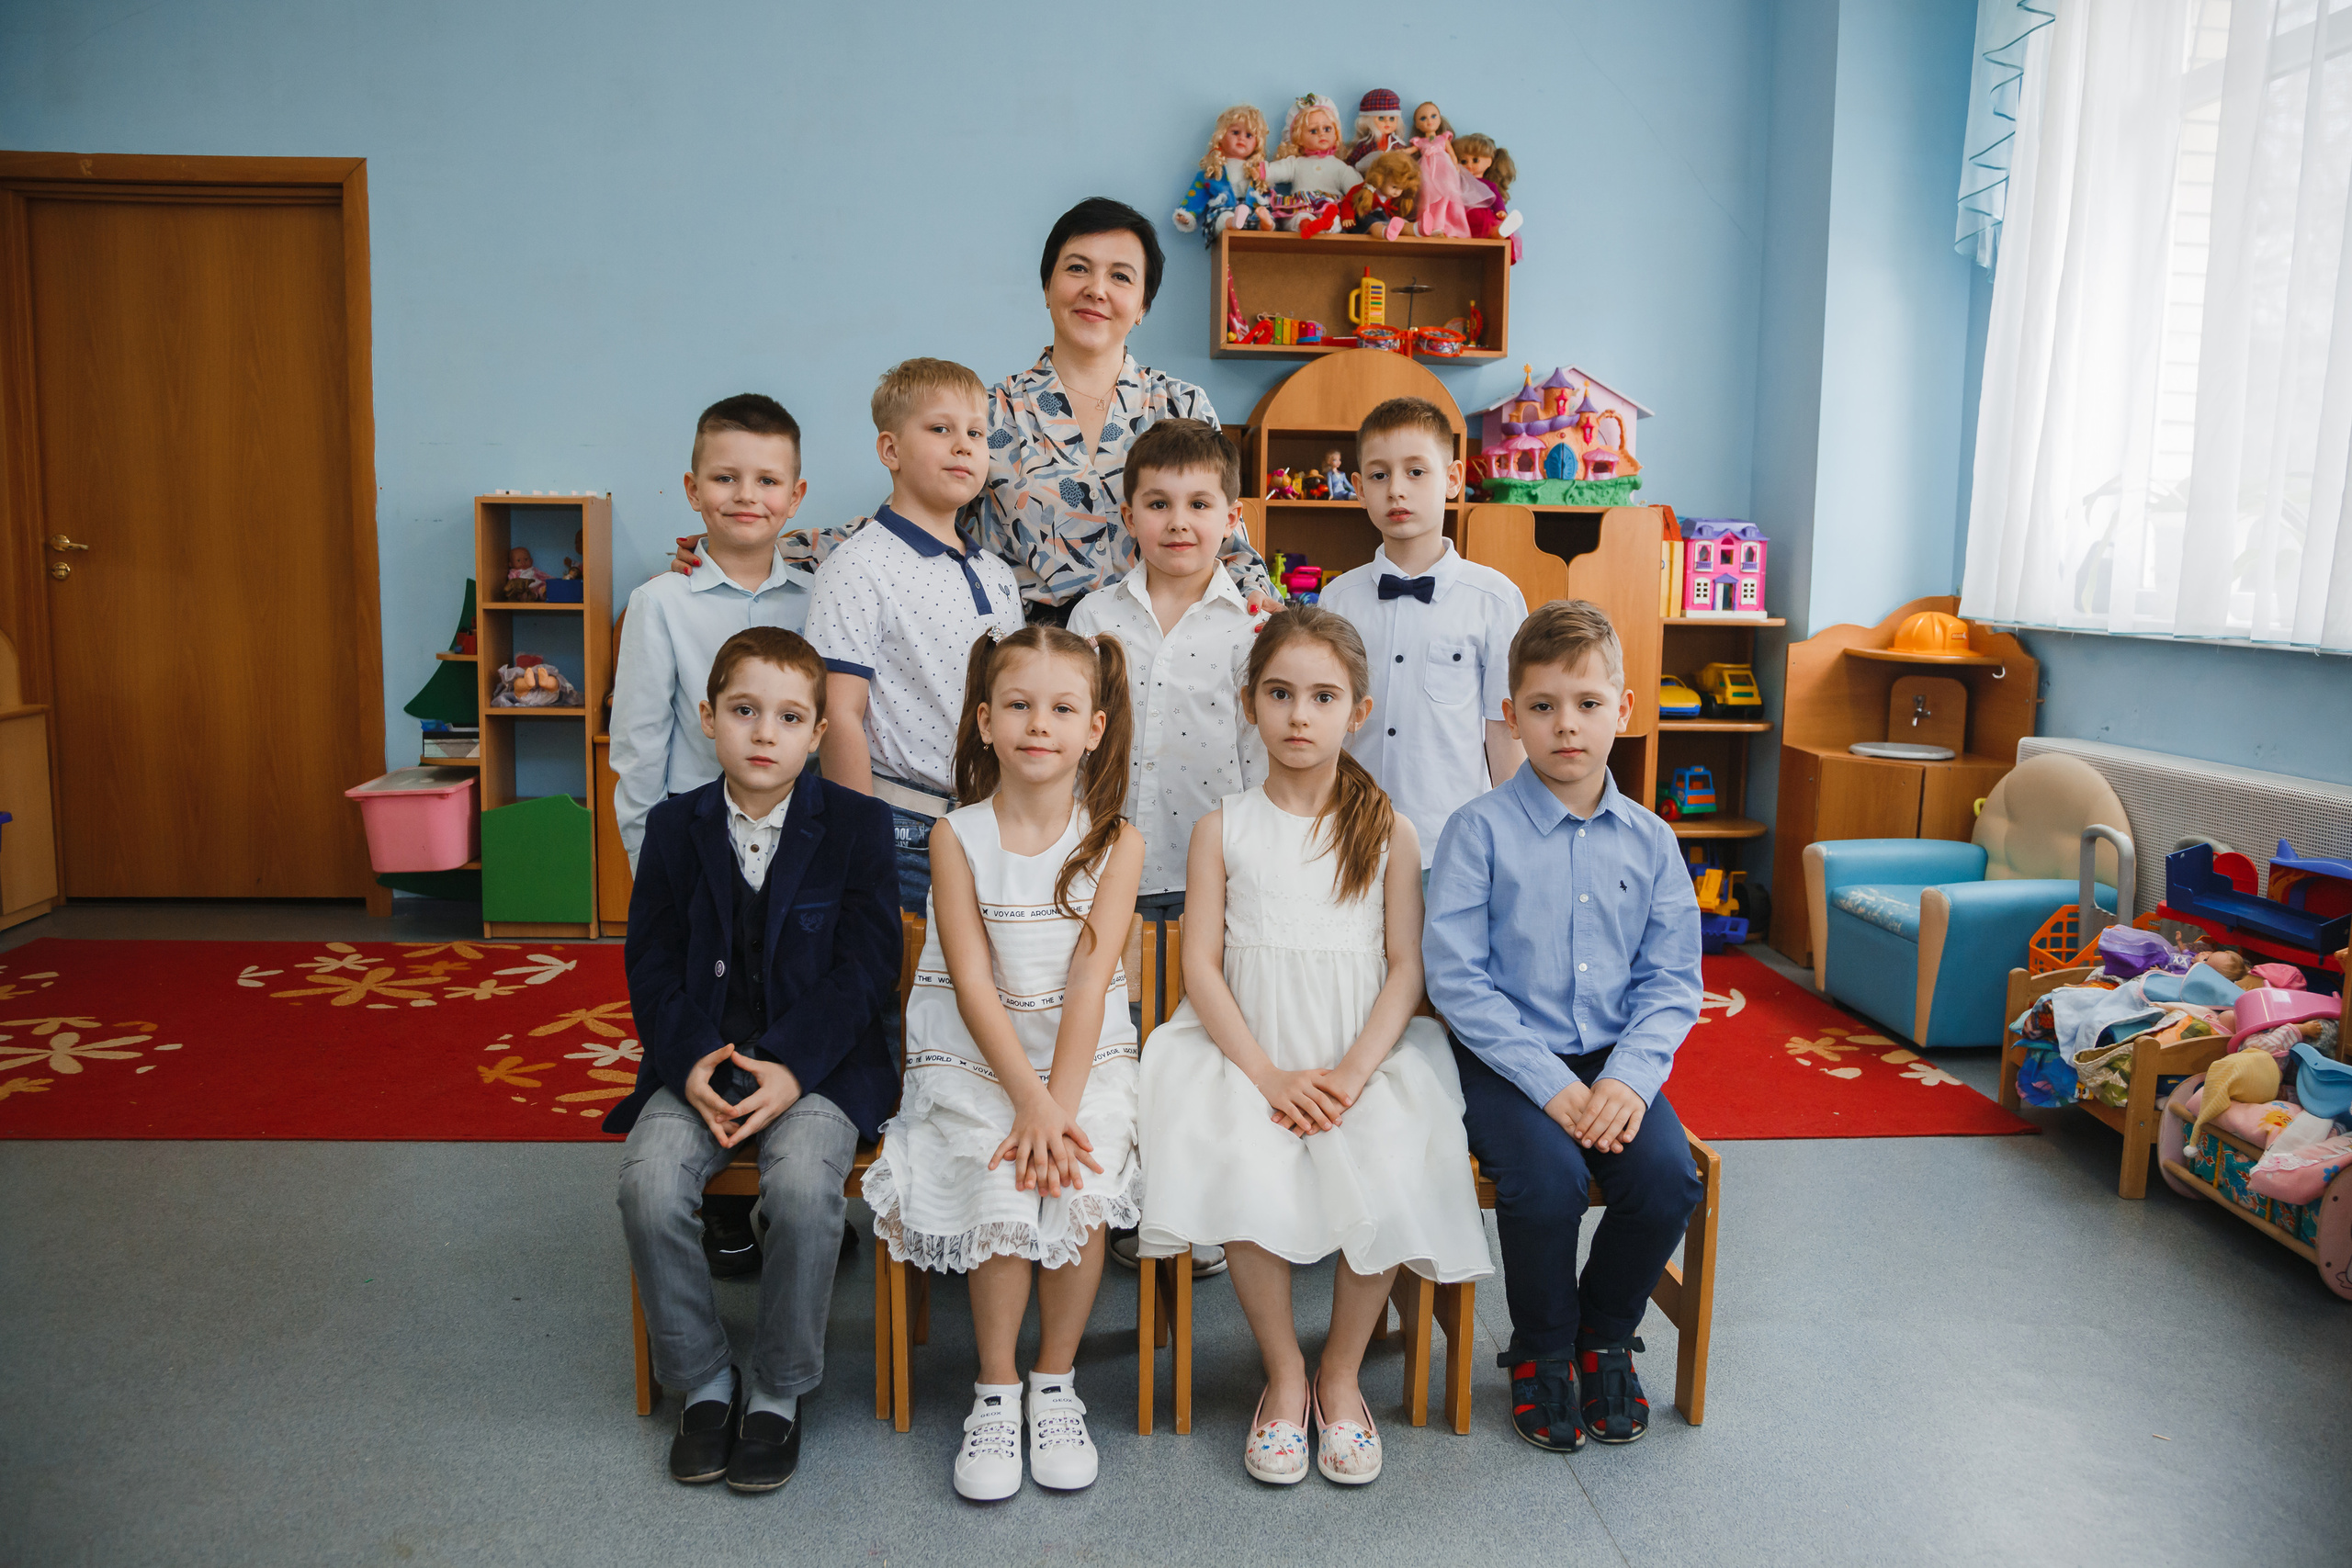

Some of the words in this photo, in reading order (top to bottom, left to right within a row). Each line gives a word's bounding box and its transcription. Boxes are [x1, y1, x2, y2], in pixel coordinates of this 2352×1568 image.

[895, 828, 912, 840] OOL
[1030, 908, 1063, 918] AROUND
[918, 975, 933, 983] THE
[1006, 998, 1035, 1008] AROUND
[1093, 1048, 1120, 1062] VOYAGE
[925, 1055, 952, 1063] WORLD
[973, 1066, 997, 1078] VOYA
